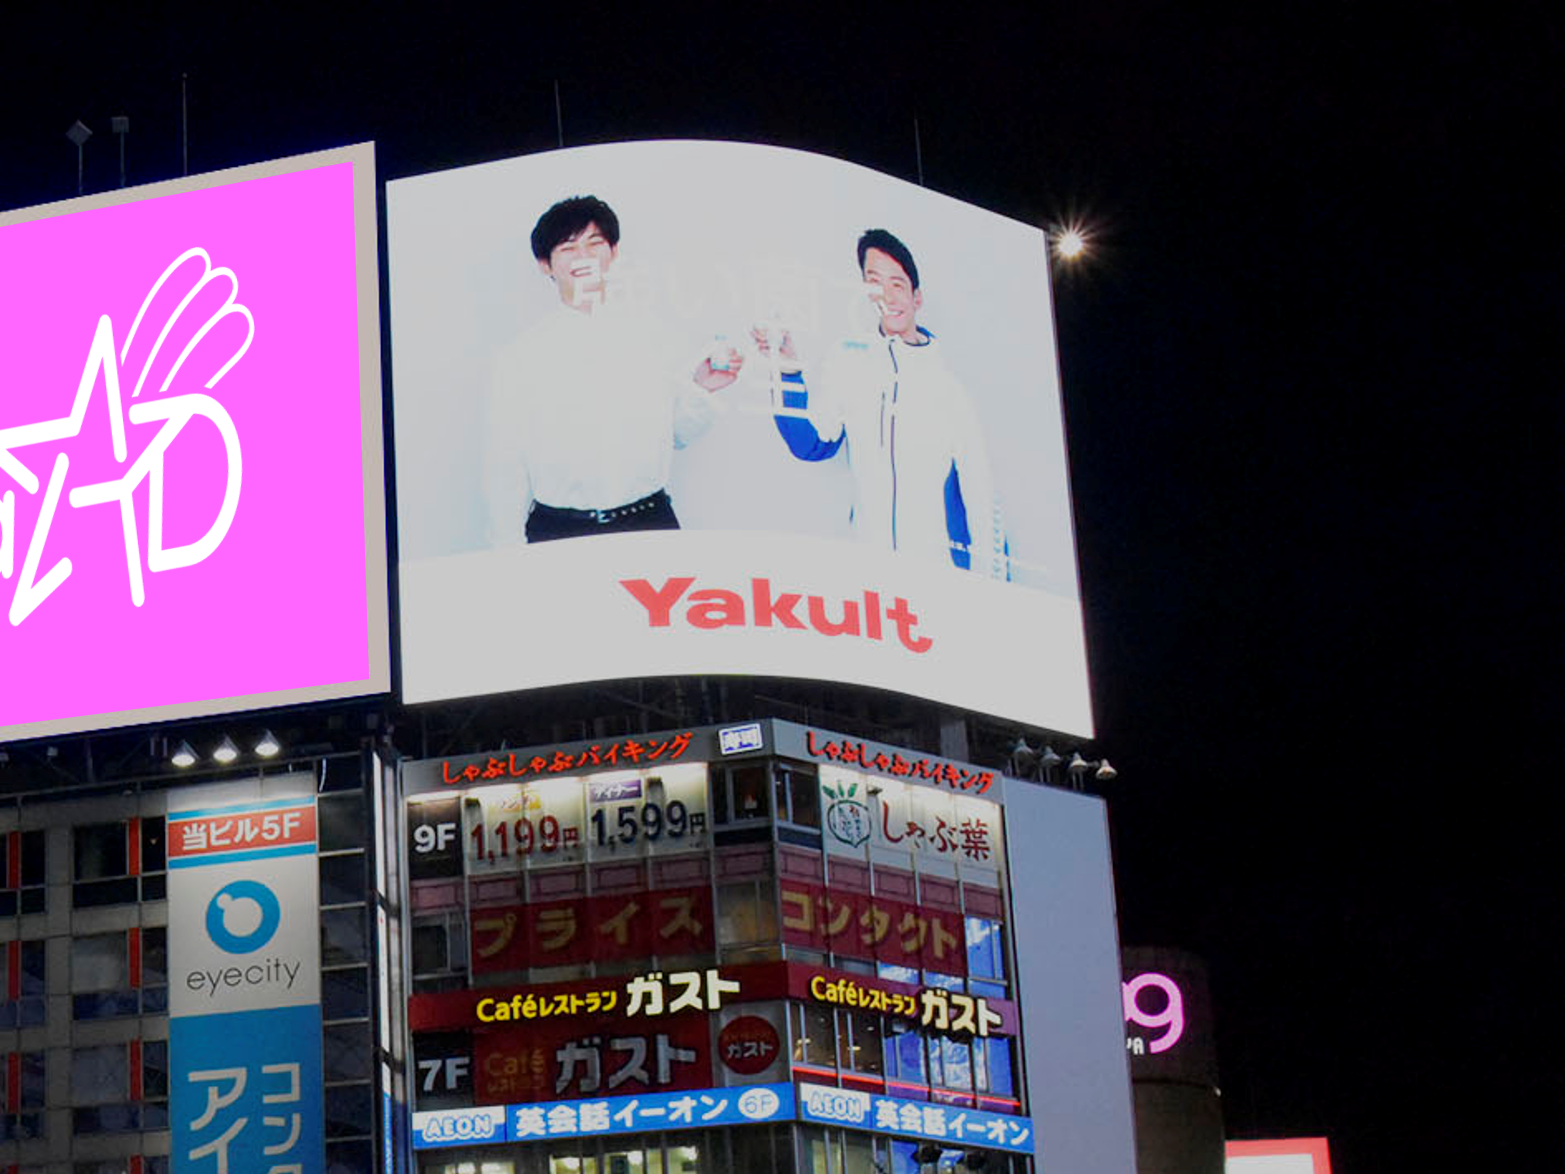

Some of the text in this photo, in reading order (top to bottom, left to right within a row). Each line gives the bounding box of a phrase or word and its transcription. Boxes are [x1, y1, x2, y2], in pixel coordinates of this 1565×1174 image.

[618, 575, 935, 655] Yakult
[443, 731, 694, 785] しゃぶしゃぶバイキング
[806, 731, 995, 795] しゃぶしゃぶバイキング
[181, 812, 302, 852] 当ビル5F
[413, 822, 456, 853] 9F
[882, 800, 991, 861] しゃぶ葉
[473, 897, 704, 957] プライス
[781, 890, 959, 959] コンタクト
[186, 958, 302, 997] eyecity
[626, 970, 741, 1017] ガスト
[921, 989, 1003, 1036] ガスト
[418, 1056, 470, 1091] 7F
[556, 1033, 697, 1095] ガスト
[424, 1114, 493, 1140] AEON
[516, 1095, 729, 1138] 英会話イーオン
[810, 1092, 863, 1118] AEON
[875, 1100, 1030, 1145] 英会話イーオン
